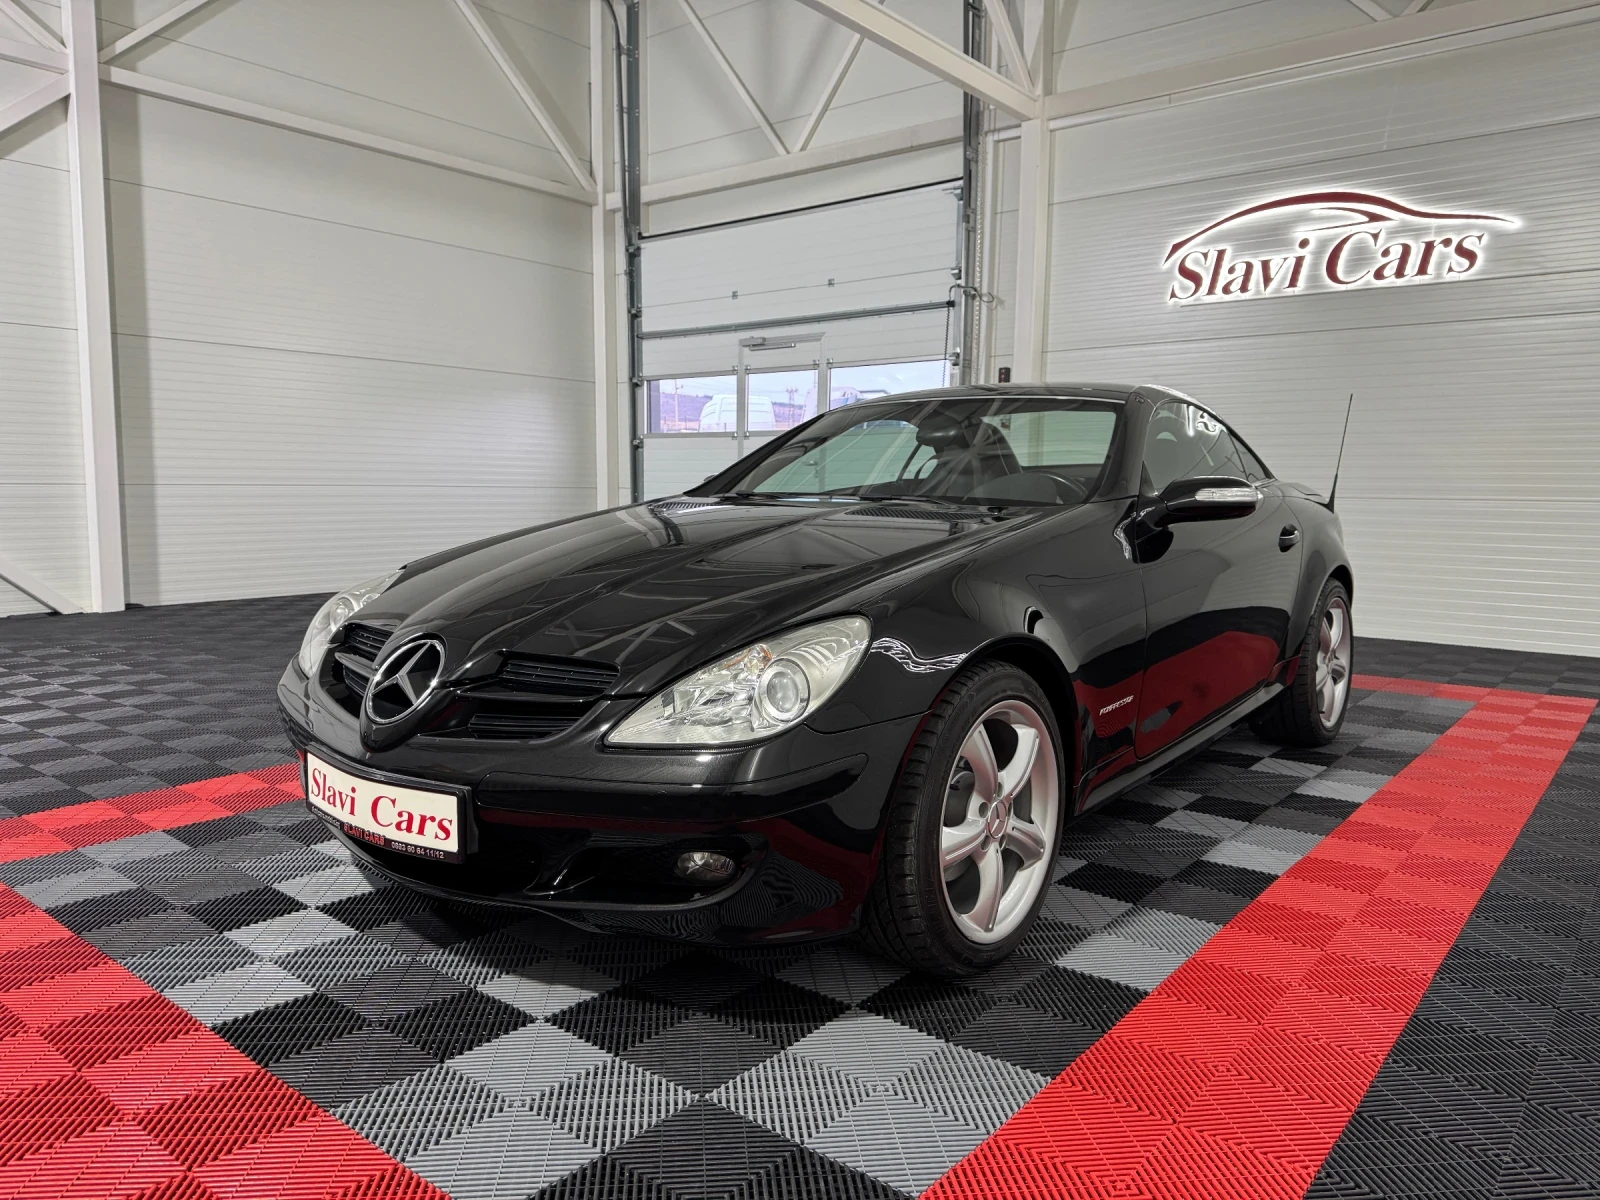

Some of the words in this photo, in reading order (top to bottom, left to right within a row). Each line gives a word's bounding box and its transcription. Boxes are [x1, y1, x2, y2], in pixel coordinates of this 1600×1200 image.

[1169, 238, 1309, 302] Slavi
[1326, 229, 1485, 285] Cars
[311, 767, 356, 816] Slavi
[371, 796, 453, 841] Cars
[344, 822, 363, 839] SLAVI
[364, 831, 385, 845] CARS
[416, 847, 425, 855] 64
[426, 849, 444, 859] 11/12
